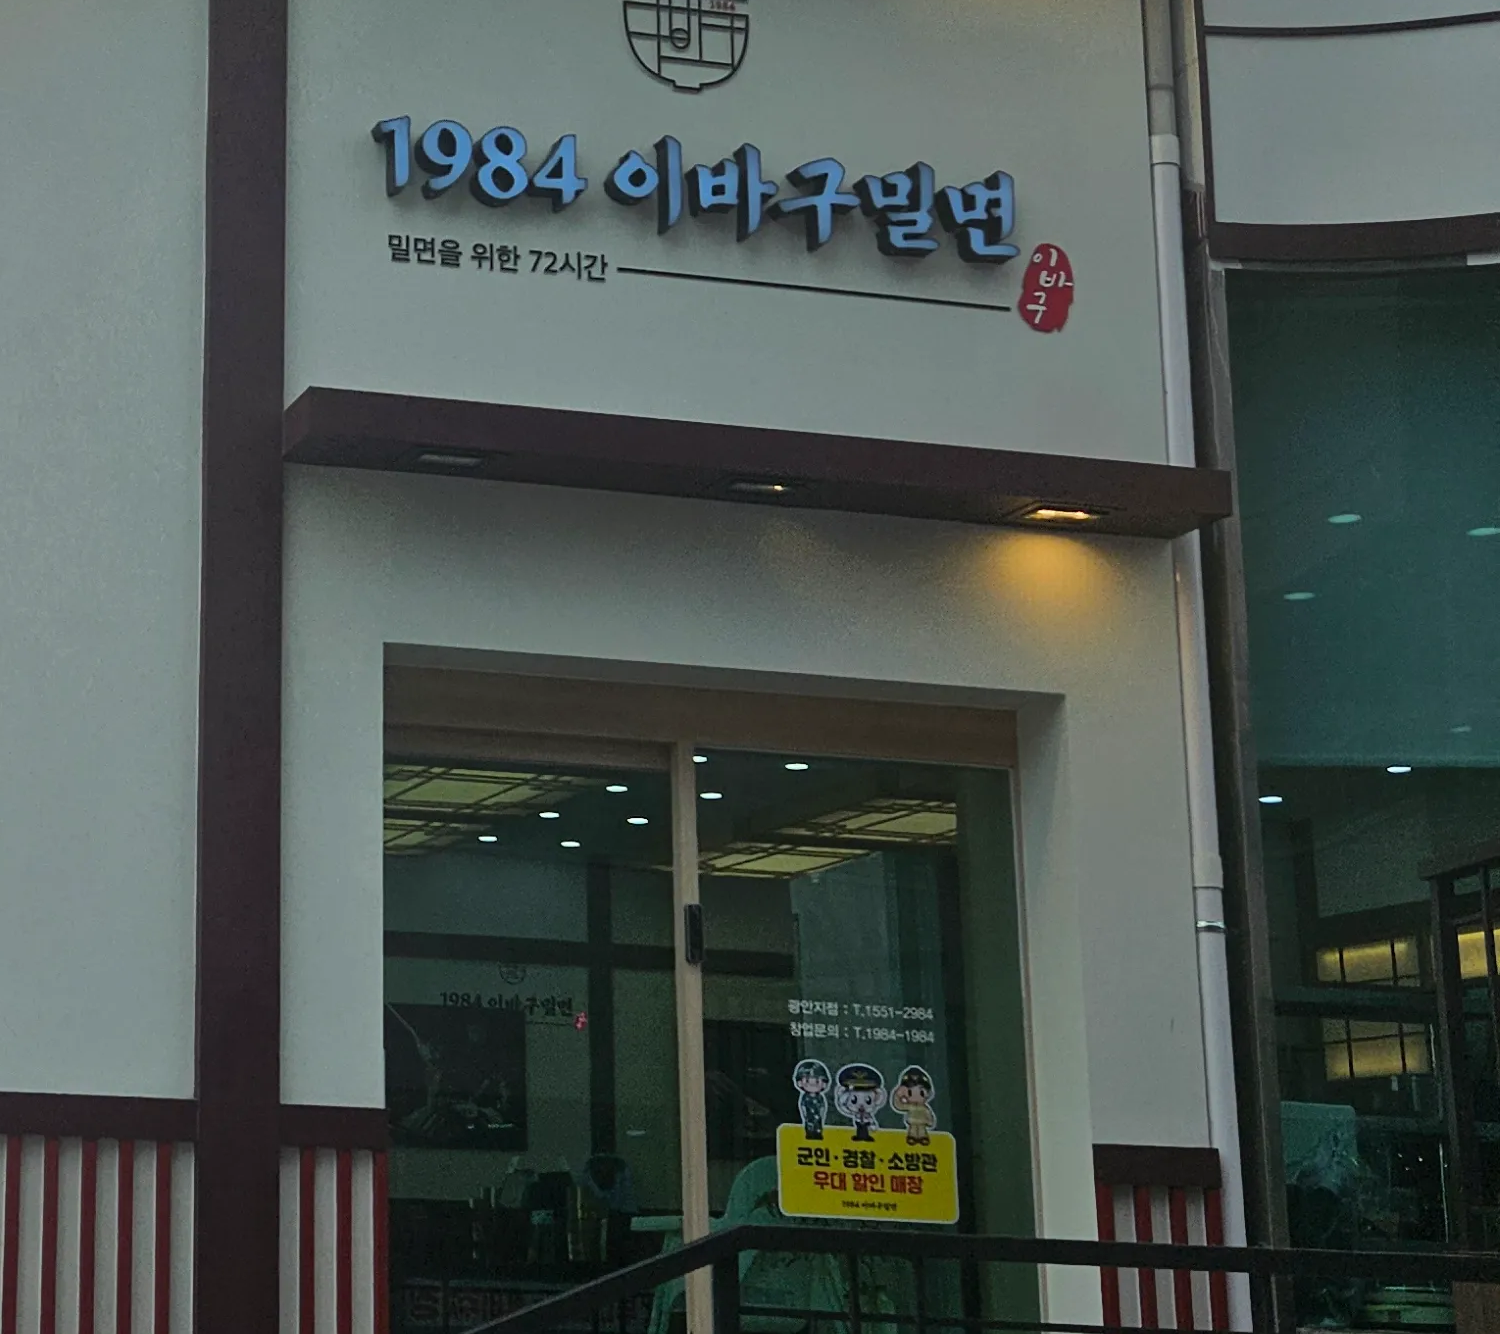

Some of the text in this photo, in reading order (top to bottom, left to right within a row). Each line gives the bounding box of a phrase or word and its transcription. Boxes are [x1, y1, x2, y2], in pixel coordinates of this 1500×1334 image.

[371, 115, 1021, 265] 1984 이바구밀면
[387, 233, 609, 284] 밀면을 위한 72시간
[1025, 248, 1075, 325] 이바구
[788, 998, 839, 1016] 광안지점
[853, 1003, 934, 1021] T.1551-2984
[789, 1021, 840, 1039] 창업문의
[853, 1026, 935, 1044] T.1984-1984
[797, 1147, 938, 1173] 군인 경찰 소방관
[813, 1170, 924, 1195] 우대 할인 매장
